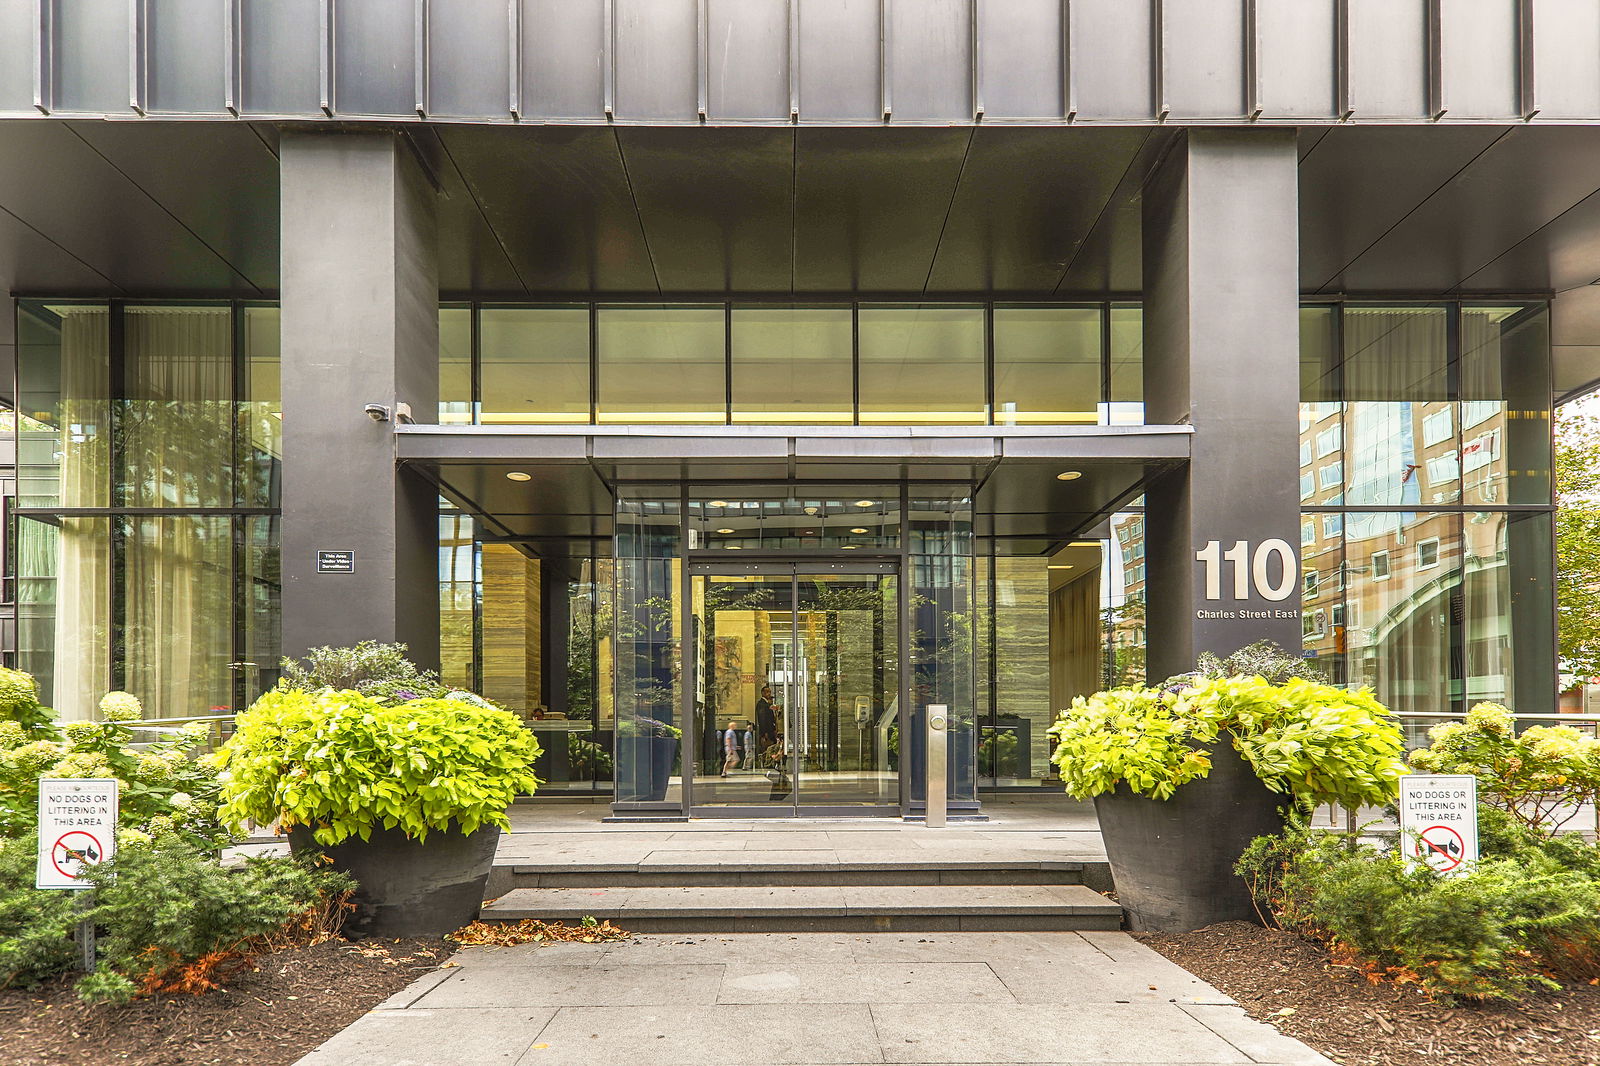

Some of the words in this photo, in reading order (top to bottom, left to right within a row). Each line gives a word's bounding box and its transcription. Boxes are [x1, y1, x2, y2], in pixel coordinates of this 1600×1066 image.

[1196, 538, 1297, 601] 110
[1197, 609, 1235, 619] Charles
[1239, 609, 1271, 619] Street
[1275, 609, 1298, 619] East
